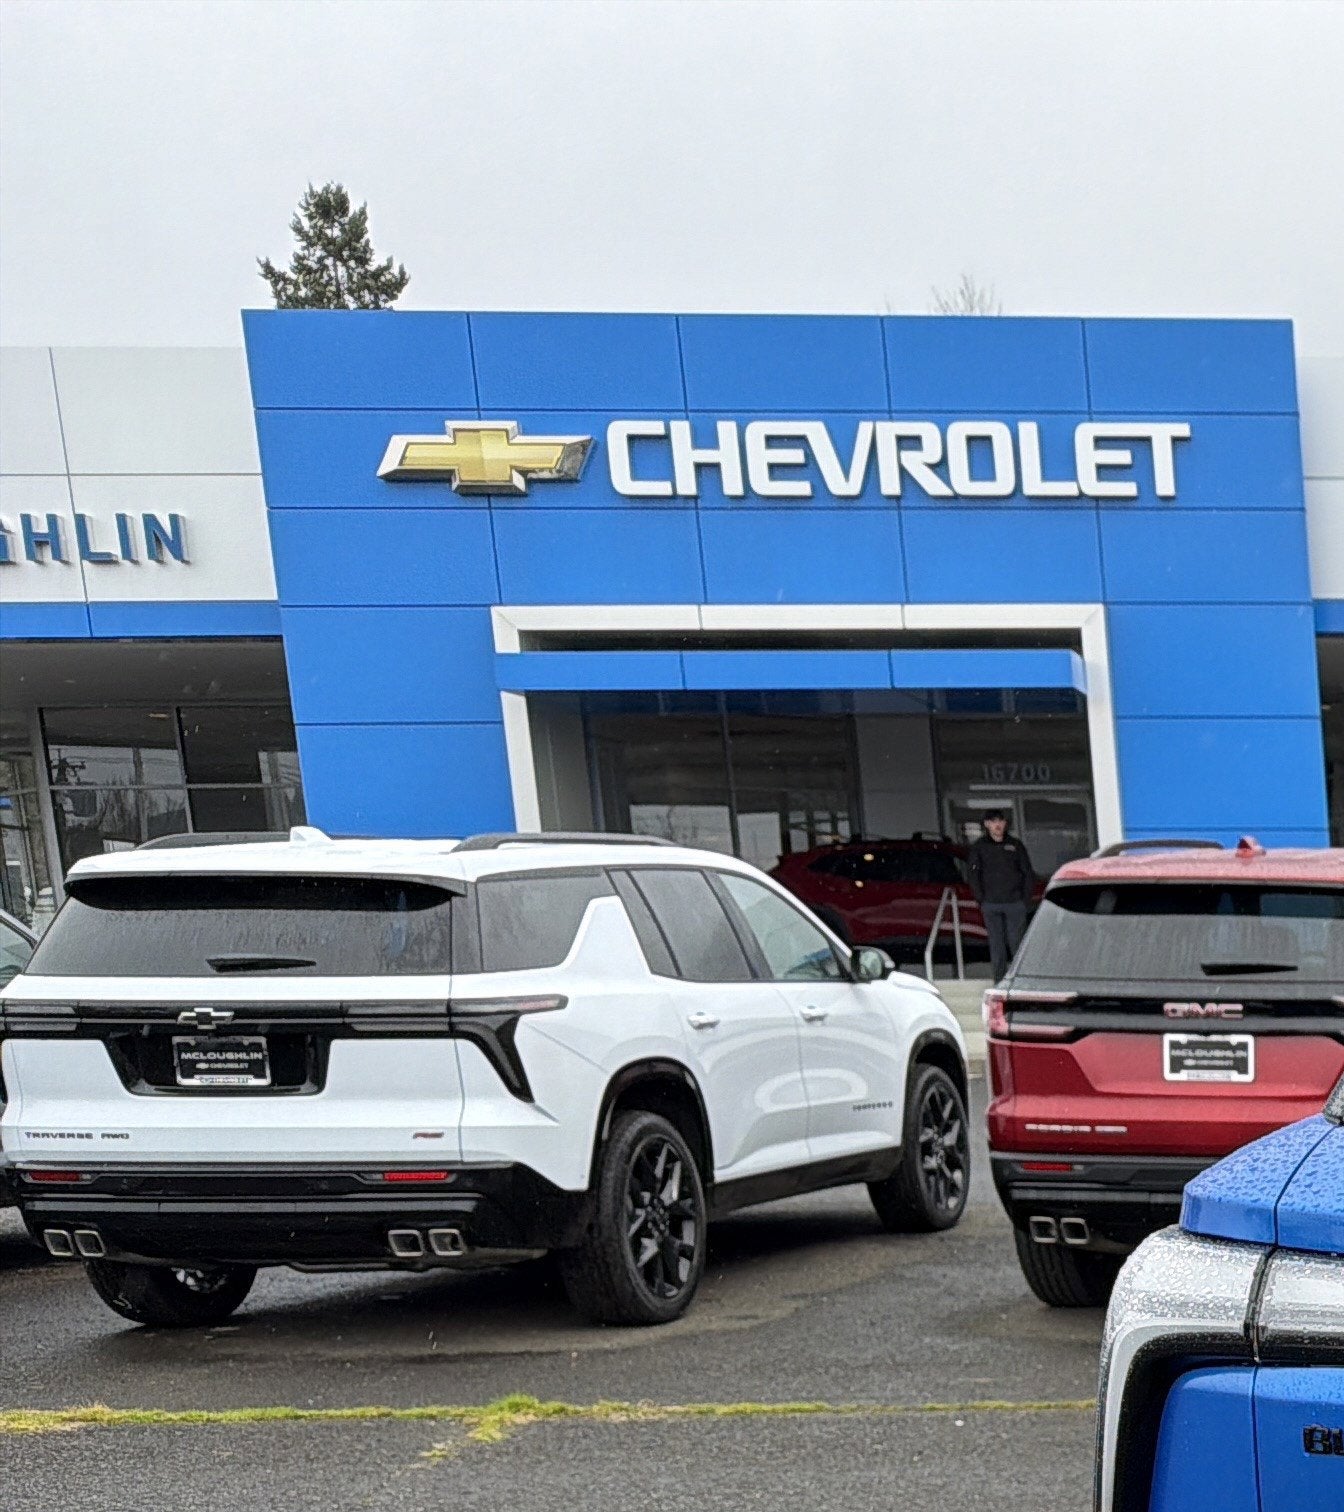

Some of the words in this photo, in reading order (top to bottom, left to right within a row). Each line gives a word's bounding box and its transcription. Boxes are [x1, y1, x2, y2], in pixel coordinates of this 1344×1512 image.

[607, 420, 1191, 498] CHEVROLET
[1163, 1002, 1243, 1018] GMC
[180, 1051, 263, 1060] MCLOUGHLIN
[24, 1131, 94, 1140] TRAVERSE
[100, 1132, 130, 1140] AWD
